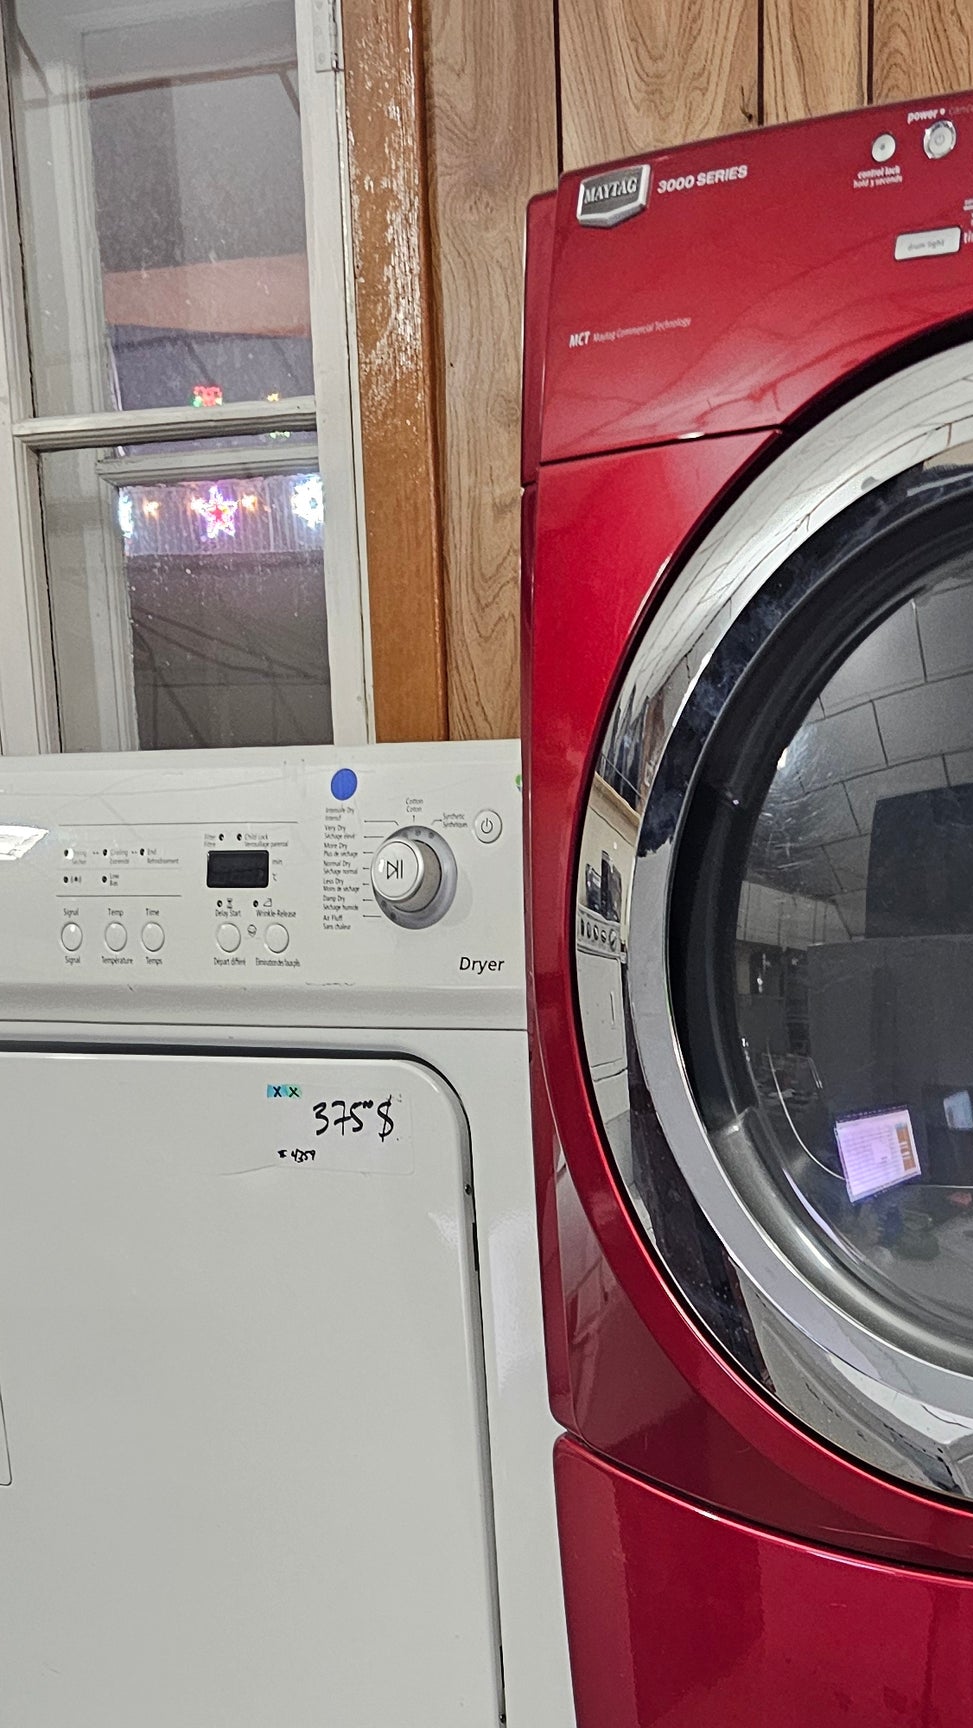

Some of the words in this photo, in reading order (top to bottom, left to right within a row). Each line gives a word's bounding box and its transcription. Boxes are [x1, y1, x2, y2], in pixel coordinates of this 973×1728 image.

[858, 168, 884, 180] control
[885, 165, 901, 176] lock
[584, 178, 639, 204] MAYTAG
[657, 174, 695, 194] 3000
[696, 165, 748, 186] SERIES
[569, 331, 590, 349] MCT
[655, 316, 692, 334] Technology
[406, 798, 424, 806] Cotton
[338, 824, 346, 833] Dry
[339, 842, 348, 850] Dry
[342, 860, 351, 868] Dry
[64, 908, 80, 918] Signal
[108, 907, 124, 918] Temp
[145, 907, 160, 917] Time
[459, 956, 505, 975] Dryer
